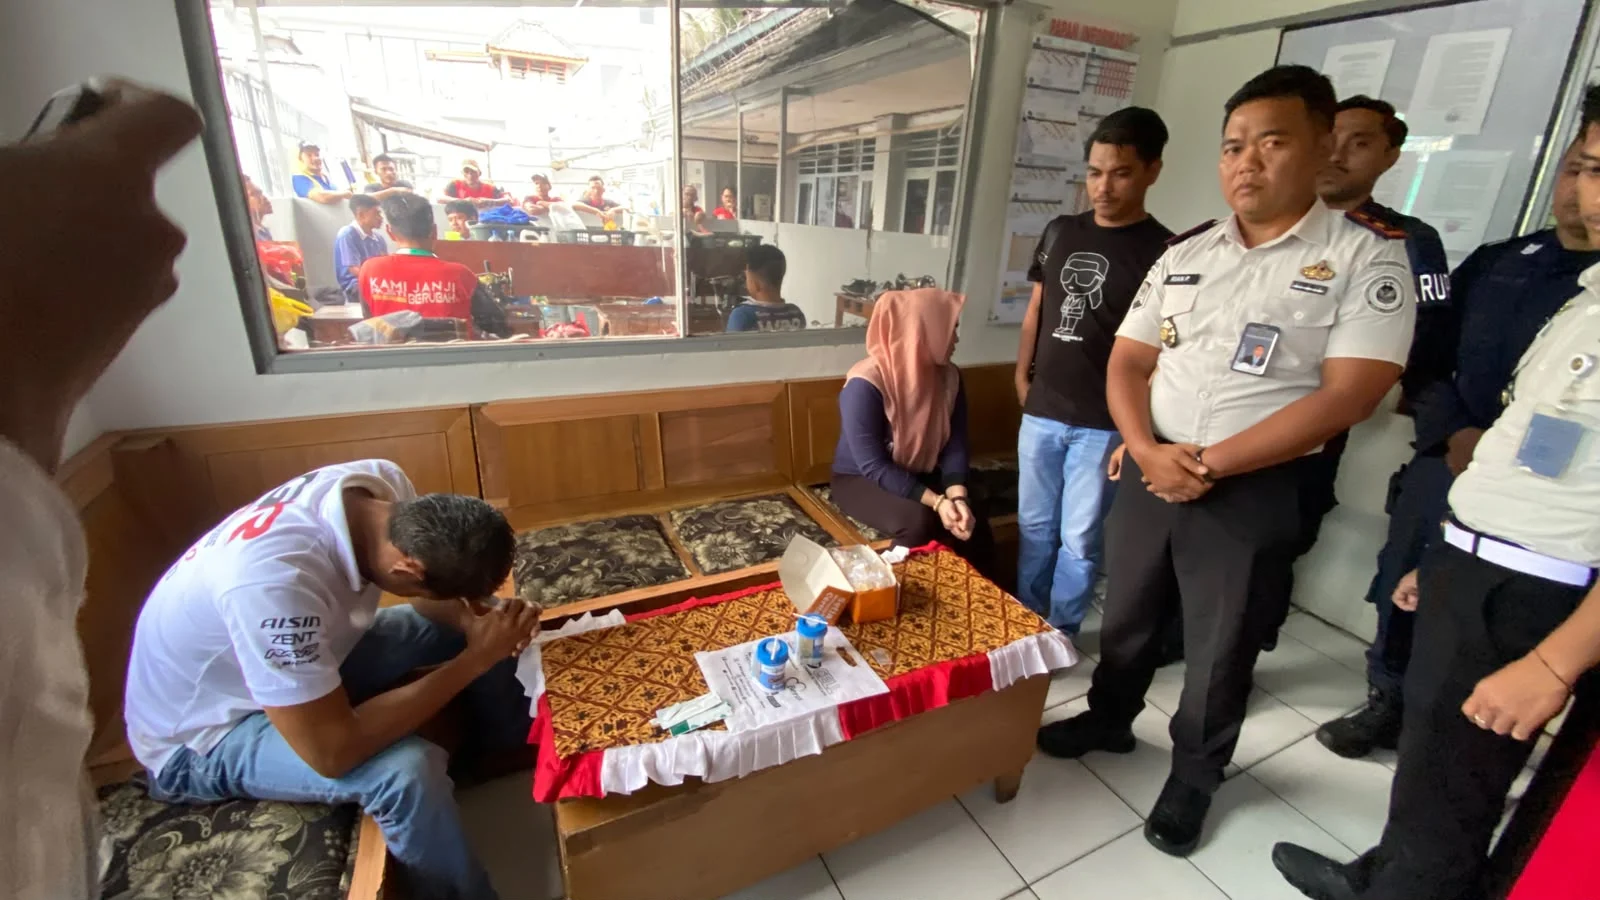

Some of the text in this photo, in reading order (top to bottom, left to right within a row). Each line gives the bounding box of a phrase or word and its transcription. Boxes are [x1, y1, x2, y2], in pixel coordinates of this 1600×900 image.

[369, 277, 456, 293] KAMI JANJI
[407, 292, 457, 305] BERUBAH
[260, 616, 320, 629] AISIN
[270, 631, 317, 645] ZENT
